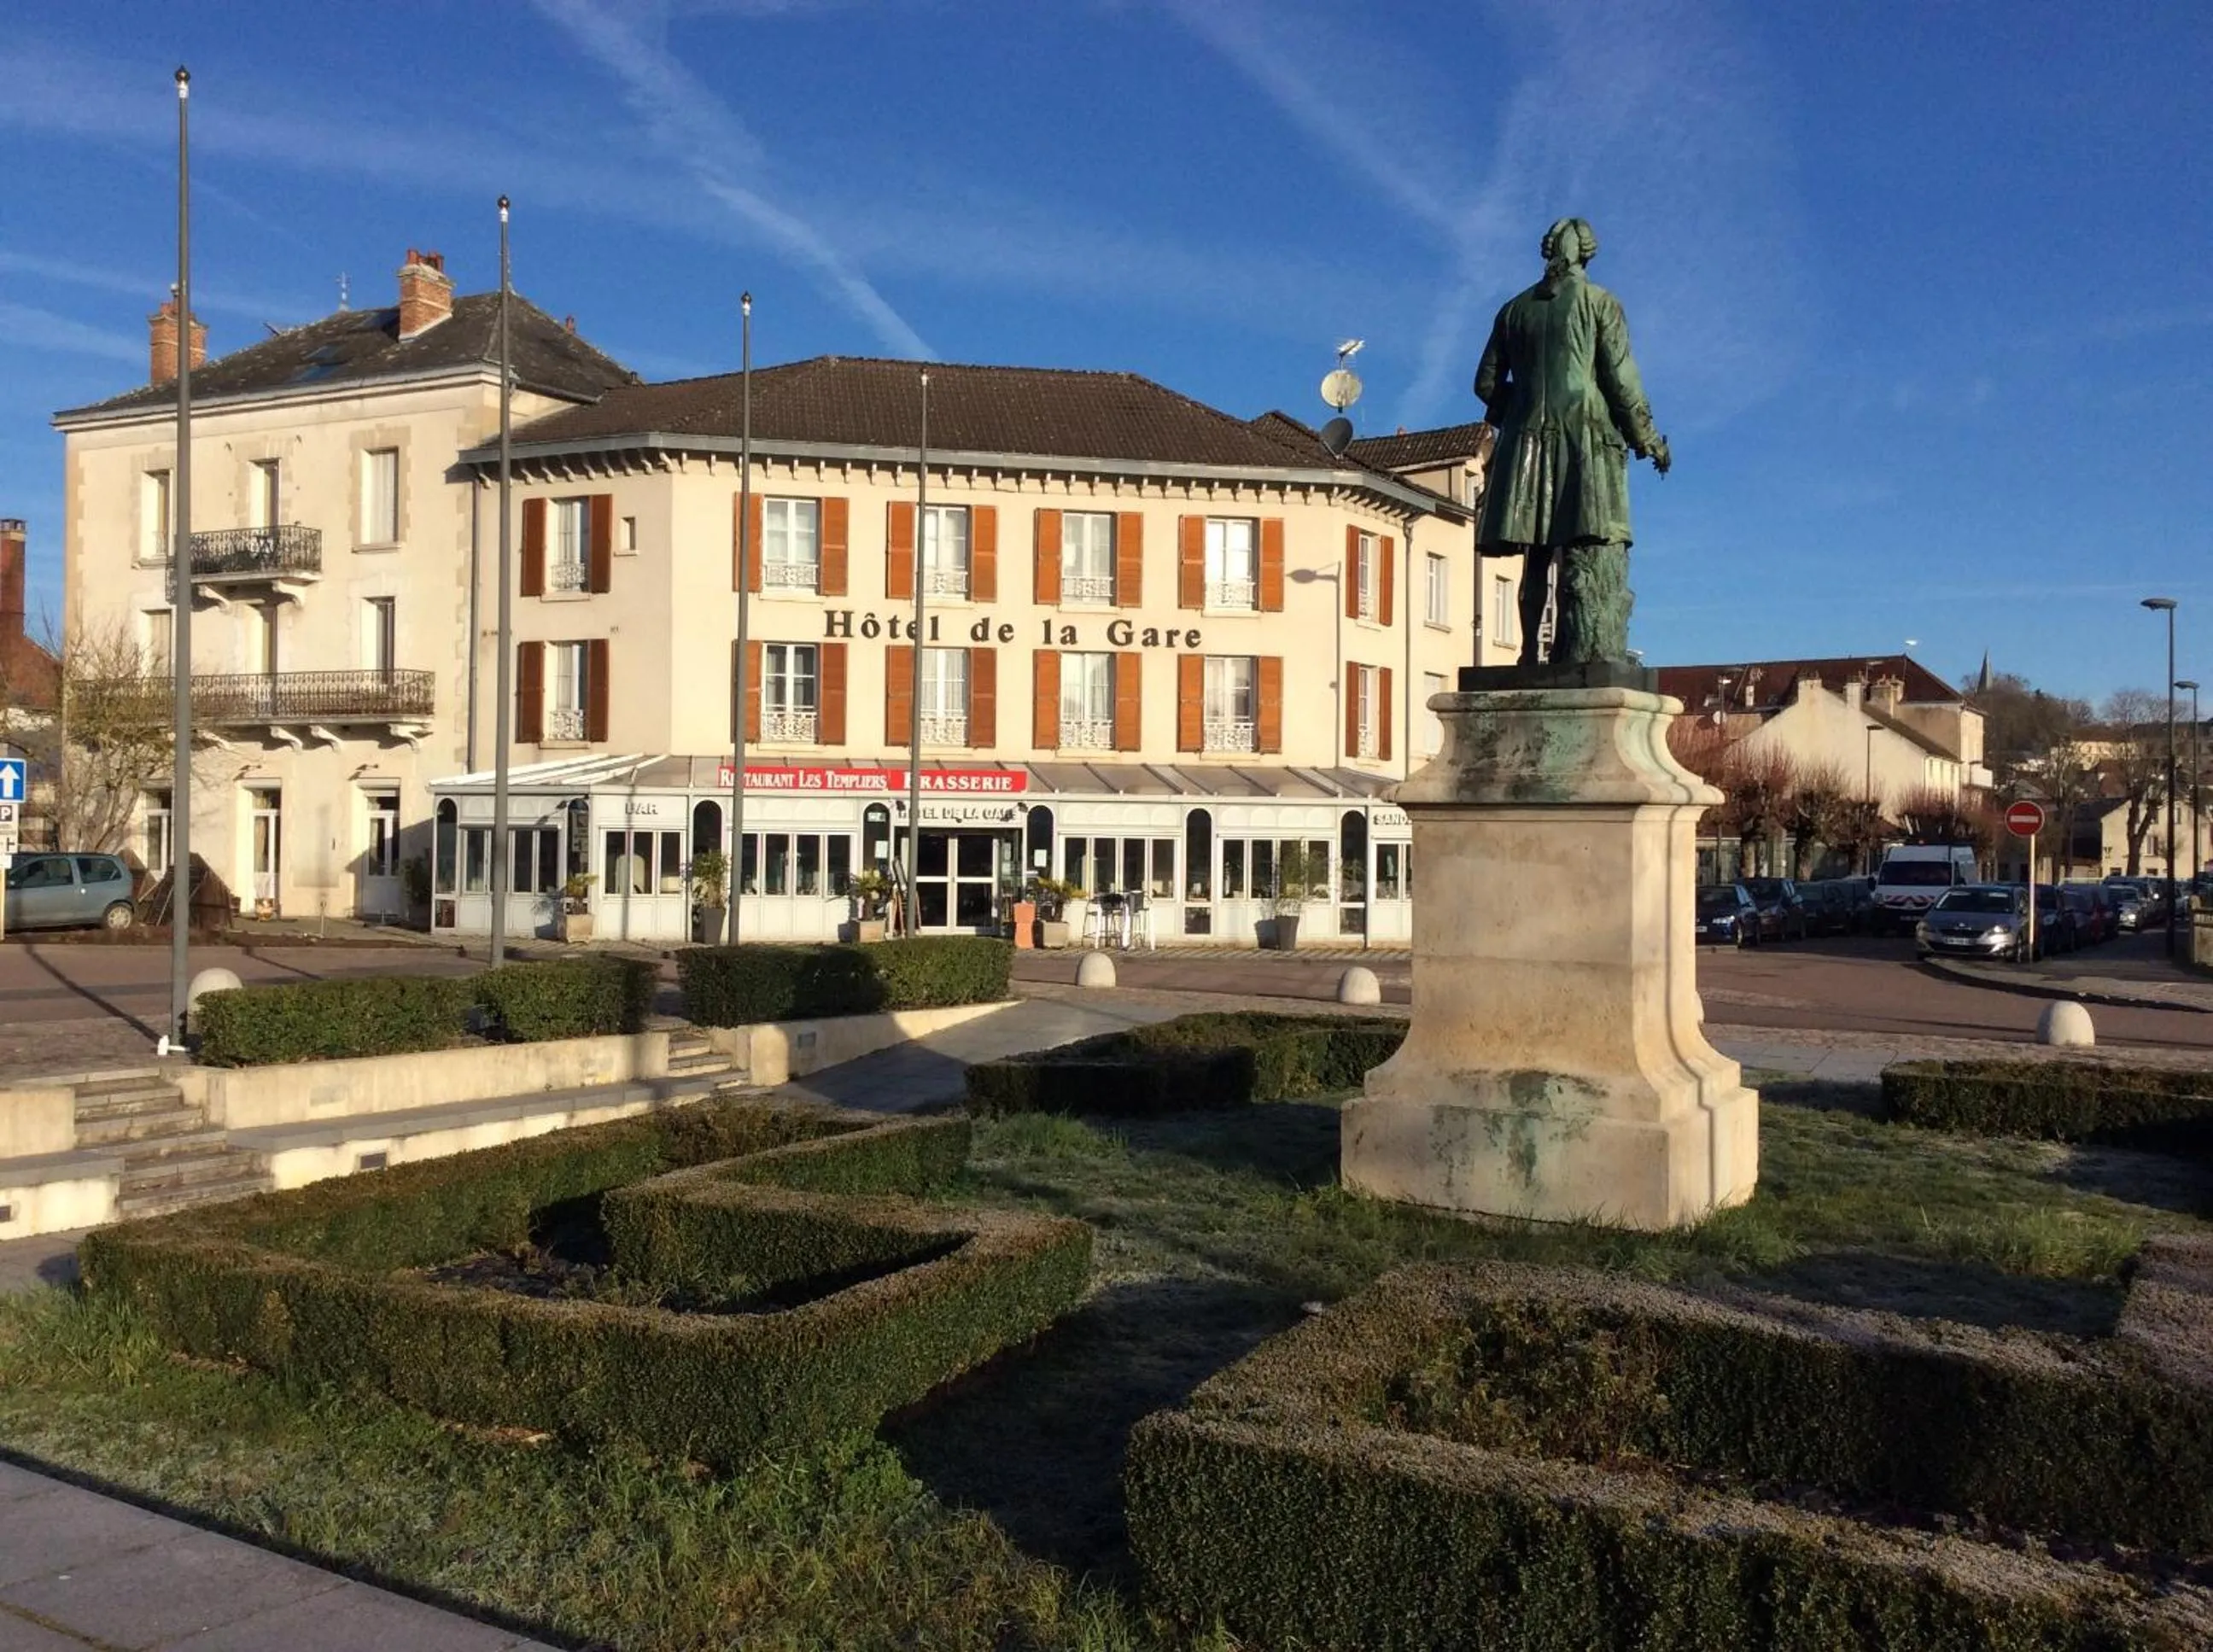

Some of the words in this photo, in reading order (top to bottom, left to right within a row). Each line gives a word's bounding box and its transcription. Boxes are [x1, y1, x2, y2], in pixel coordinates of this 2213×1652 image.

[824, 610, 939, 640] Hôtel
[970, 617, 1014, 643] de
[1042, 619, 1078, 645] la
[1106, 619, 1202, 648] Gare
[720, 768, 794, 788] RTAURANT
